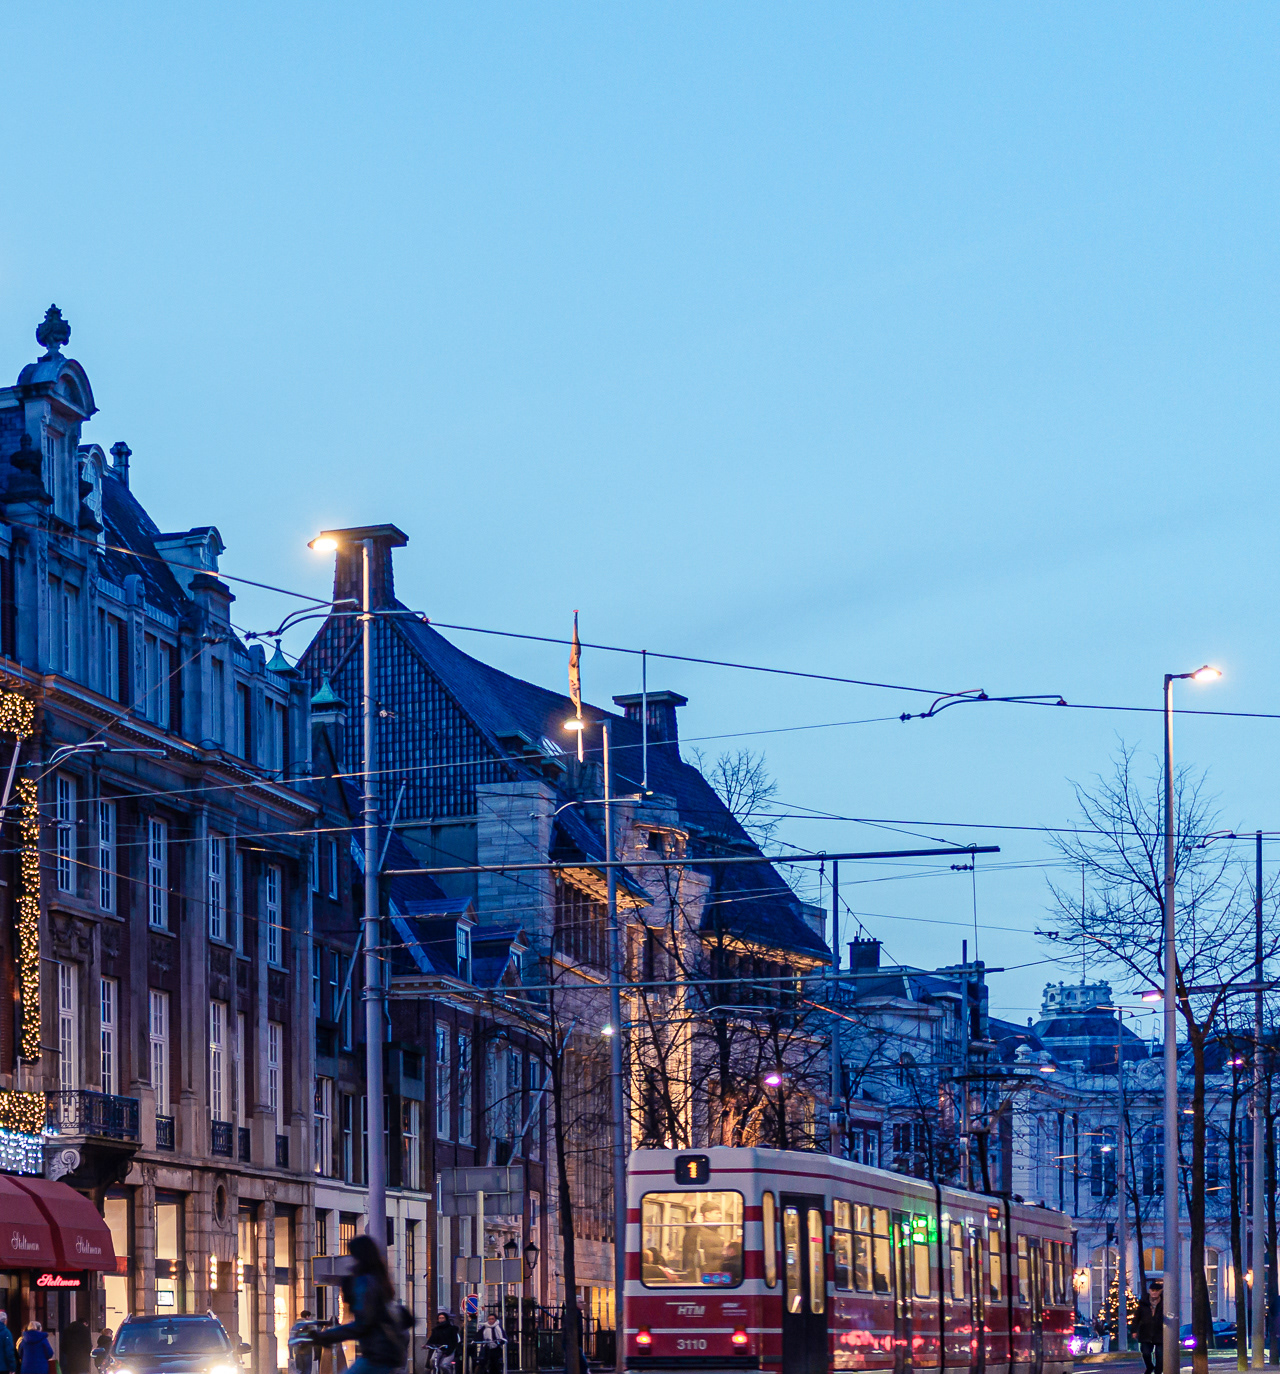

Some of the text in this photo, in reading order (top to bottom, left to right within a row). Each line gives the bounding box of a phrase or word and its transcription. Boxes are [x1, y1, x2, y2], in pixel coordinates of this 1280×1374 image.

[686, 1161, 697, 1178] 1
[11, 1231, 40, 1251] Steltman
[37, 1273, 81, 1287] Steltman
[677, 1305, 705, 1315] HTM
[676, 1339, 707, 1350] 3110
